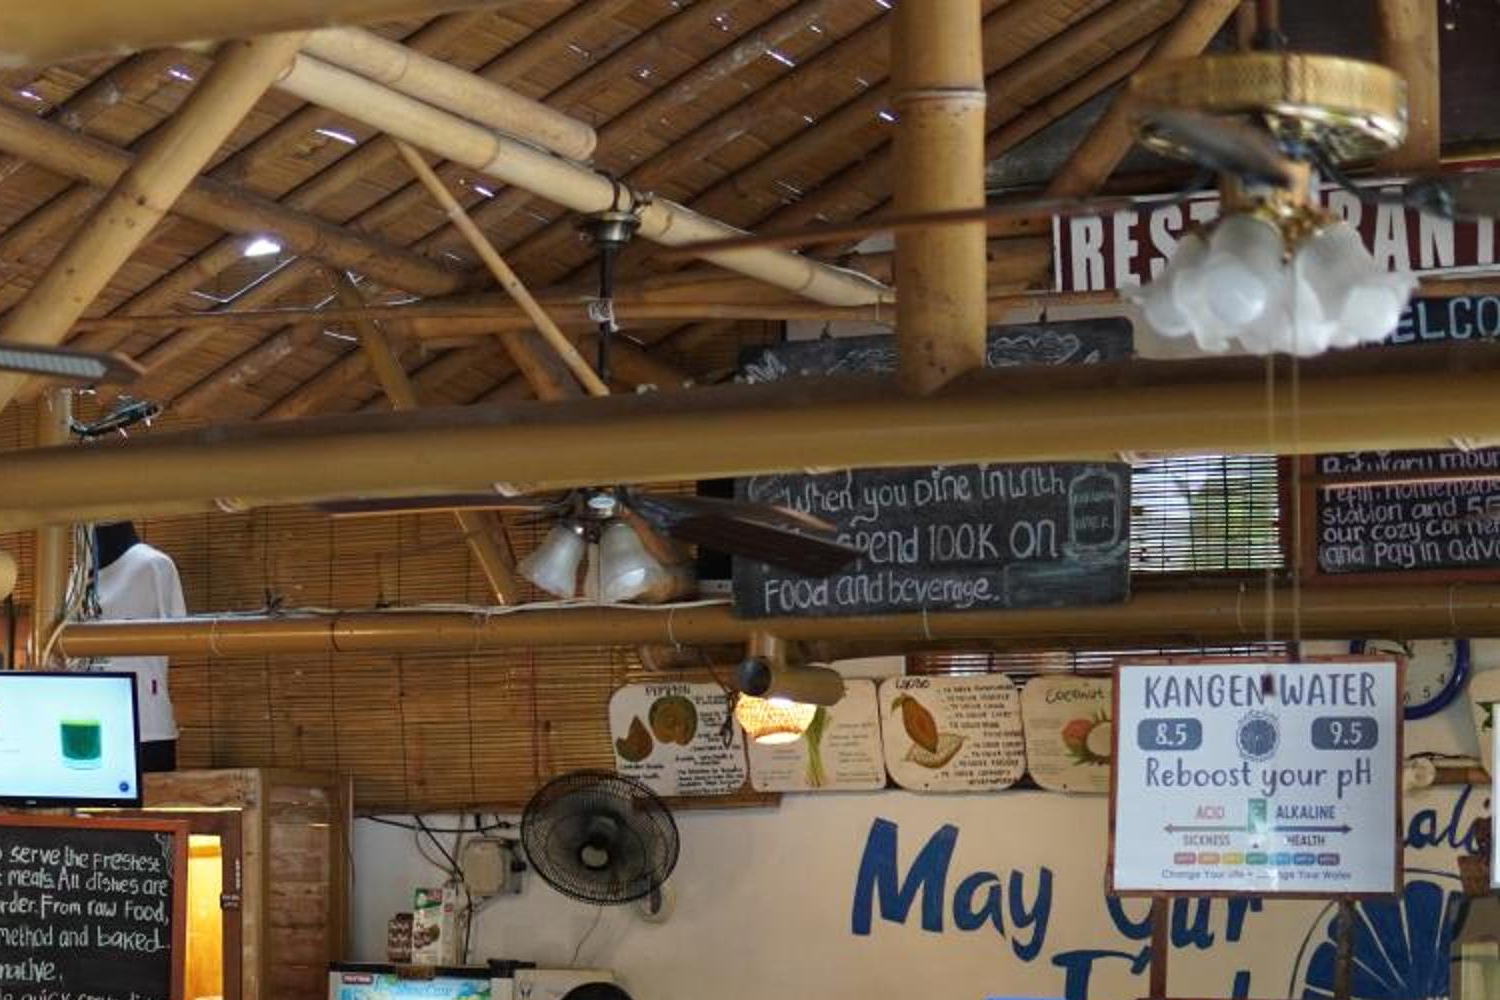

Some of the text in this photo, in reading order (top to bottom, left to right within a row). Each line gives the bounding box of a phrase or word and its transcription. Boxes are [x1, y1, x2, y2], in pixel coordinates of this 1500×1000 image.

[1143, 671, 1378, 709] KANGEN WATER
[1155, 720, 1364, 747] 8.5 9.5
[1145, 757, 1373, 798] Reboost your pH
[1274, 804, 1337, 820] ALKALINE
[851, 816, 1054, 963] May
